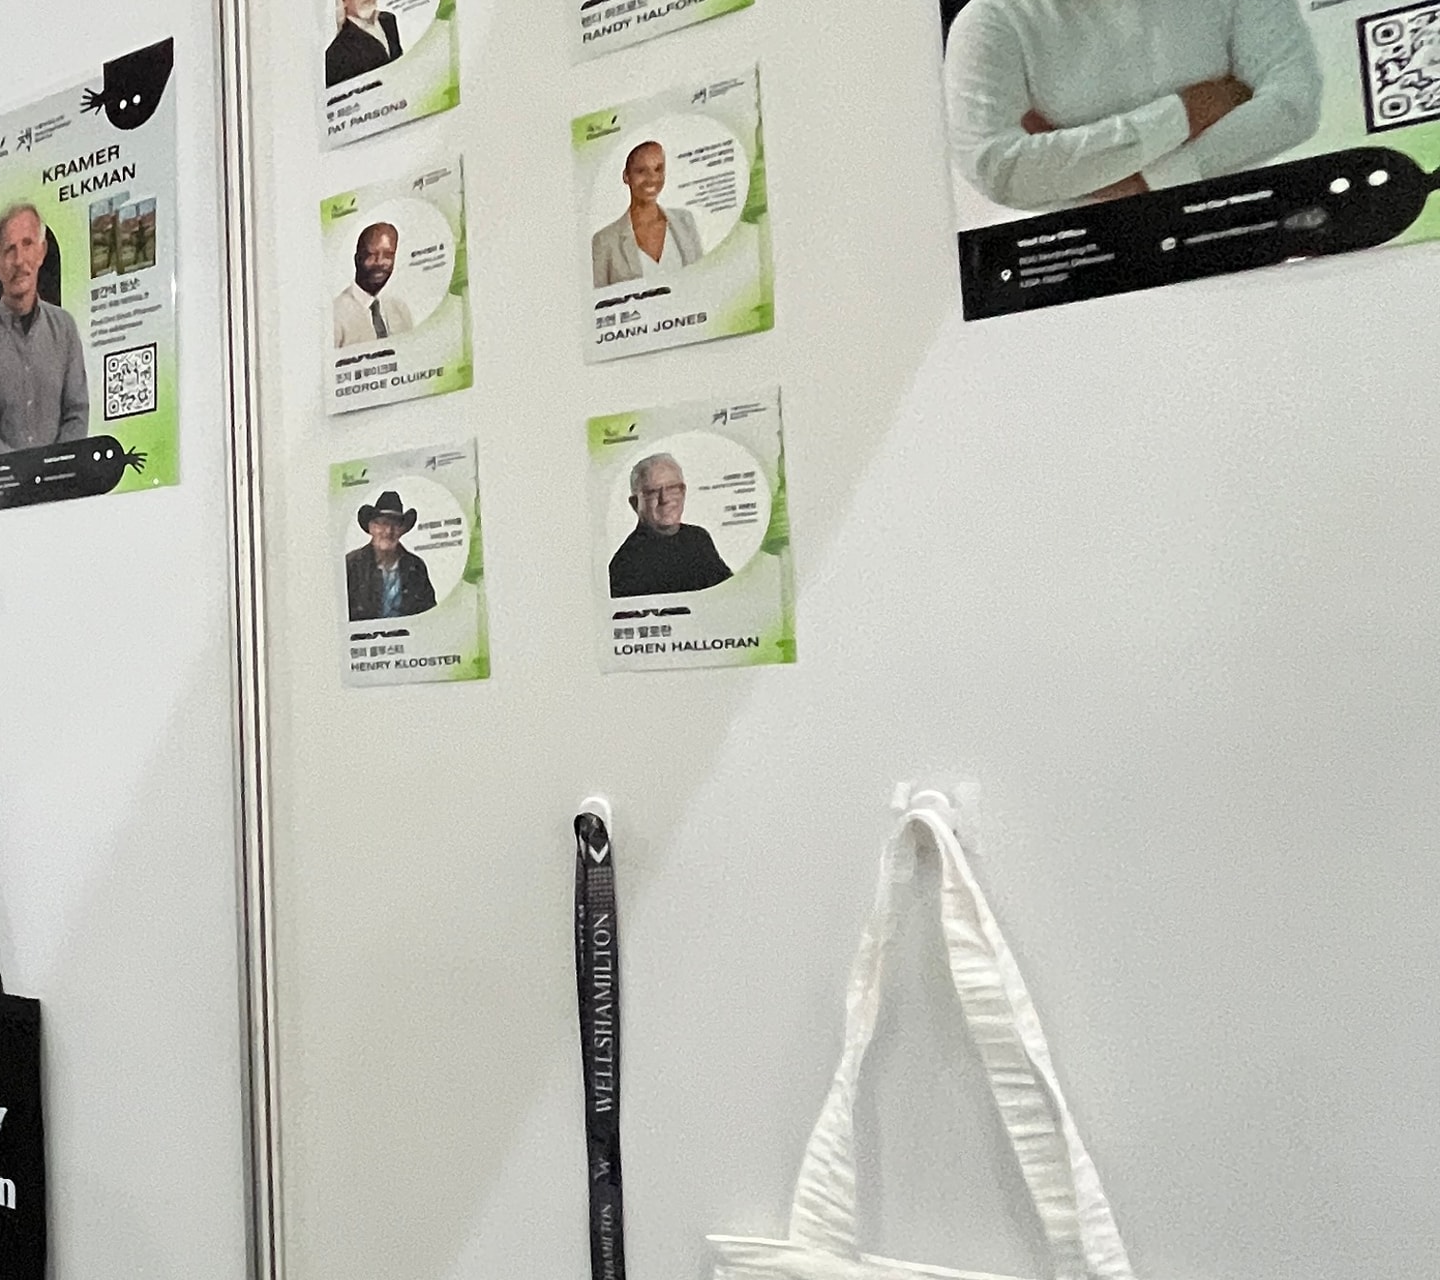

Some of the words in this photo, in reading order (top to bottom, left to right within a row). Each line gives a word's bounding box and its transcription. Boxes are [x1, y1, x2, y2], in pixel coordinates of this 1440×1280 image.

[582, 15, 633, 44] RANDY
[328, 120, 347, 136] PAT
[350, 99, 408, 128] PARSONS
[41, 144, 121, 186] KRAMER
[59, 163, 137, 203] ELKMAN
[596, 325, 648, 345] JOANN
[653, 312, 708, 333] JONES
[335, 378, 388, 398] GEORGE
[390, 366, 445, 387] OLUIKPE
[614, 642, 666, 656] LOREN
[672, 636, 760, 653] HALLORAN
[351, 660, 392, 672] HENRY
[395, 655, 461, 669] KLOOSTER
[592, 913, 614, 1113] WELLSHAMILTON
